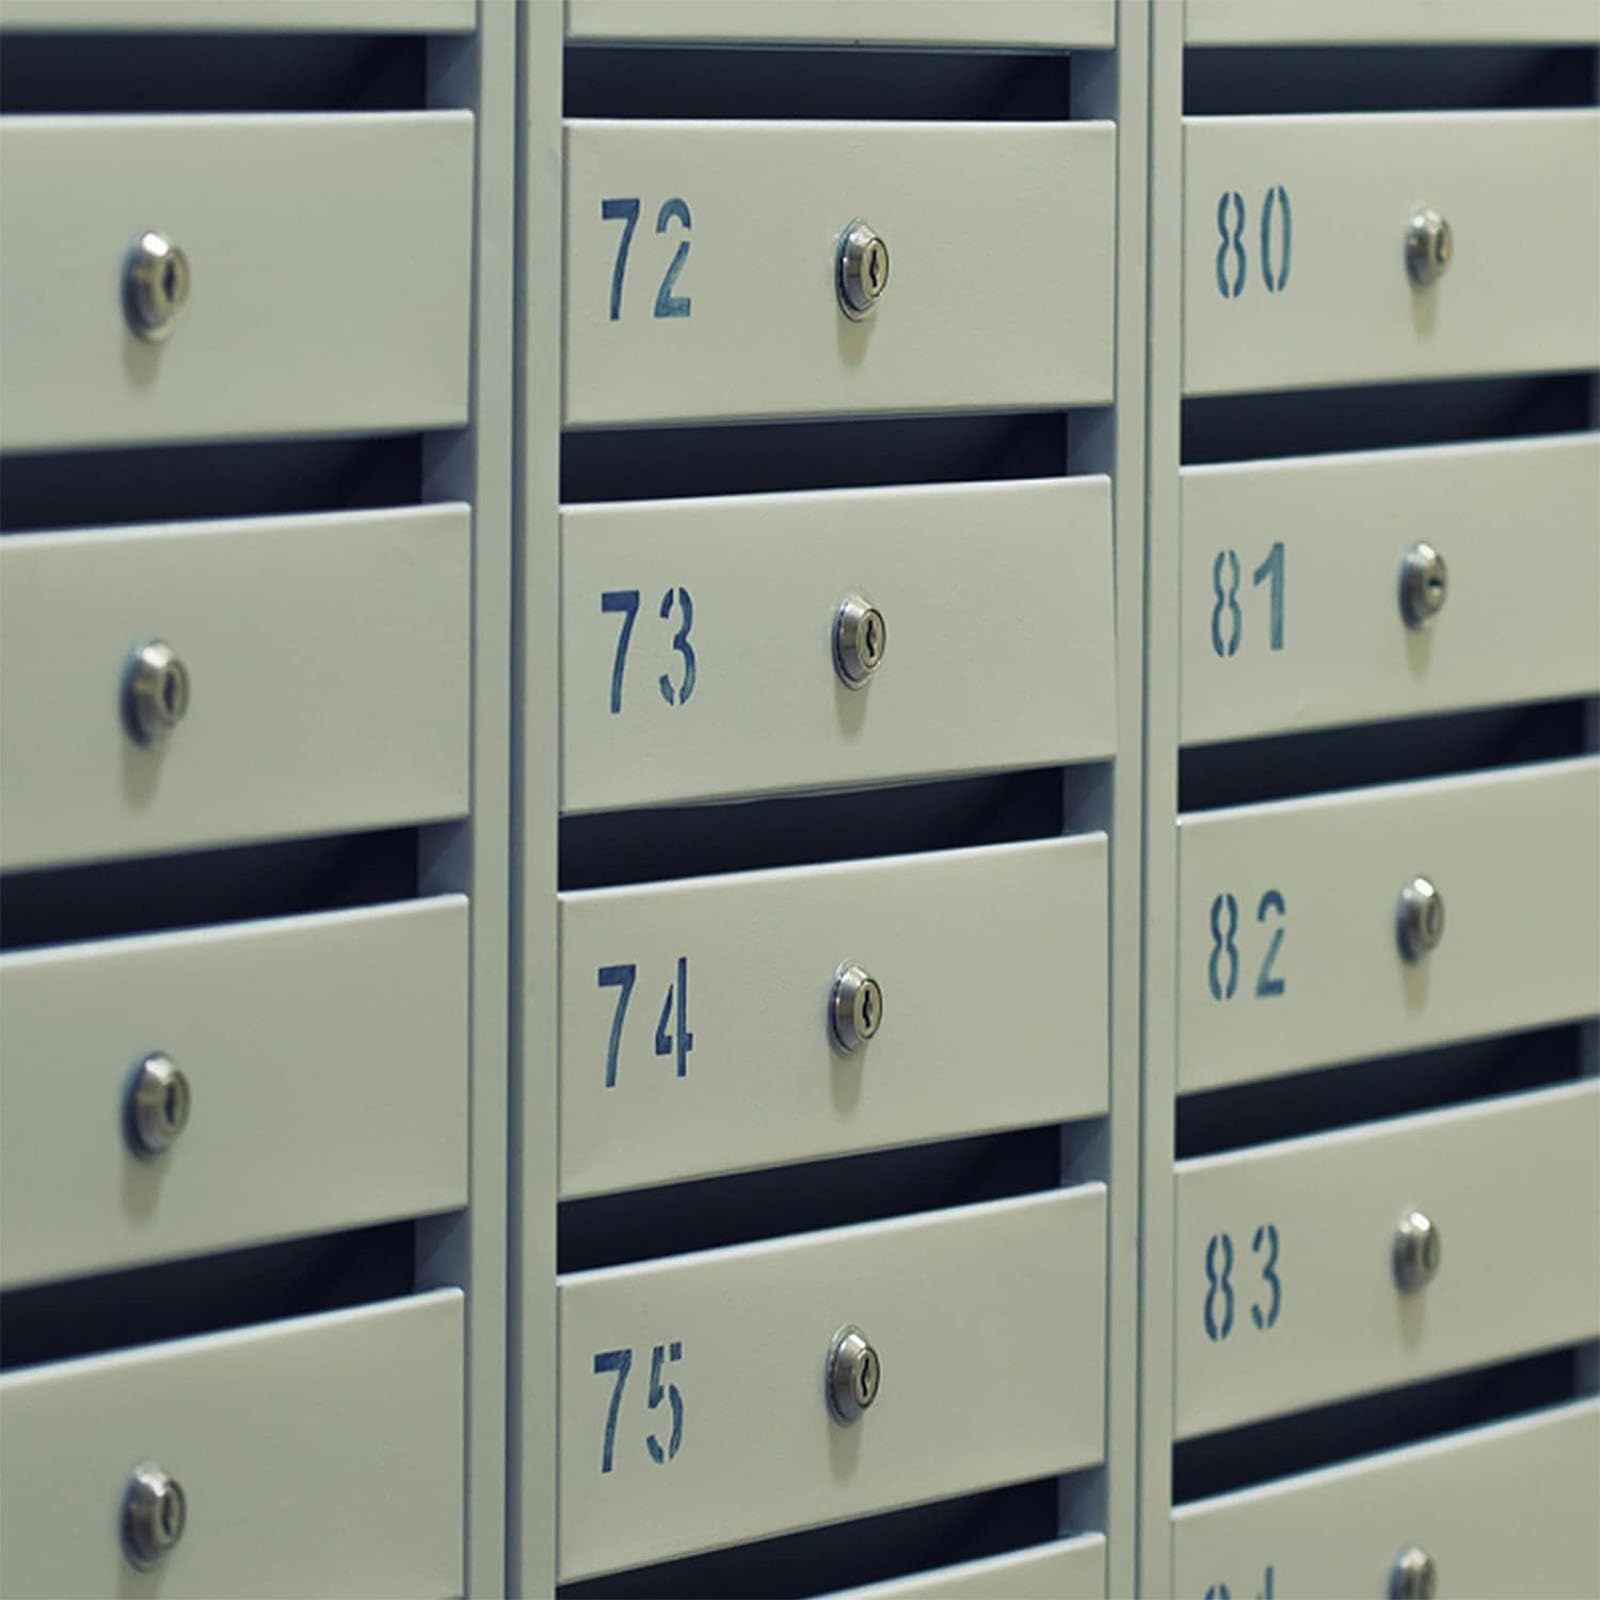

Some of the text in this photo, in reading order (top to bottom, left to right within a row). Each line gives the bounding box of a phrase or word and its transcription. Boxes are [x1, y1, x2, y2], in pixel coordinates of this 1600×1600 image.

[601, 197, 693, 320] 72
[1216, 184, 1292, 299] 80
[600, 587, 696, 714] 73
[1211, 541, 1286, 657] 81
[1208, 889, 1287, 1003] 82
[597, 957, 694, 1088] 74
[1204, 1224, 1282, 1342] 83
[593, 1342, 683, 1473] 75
